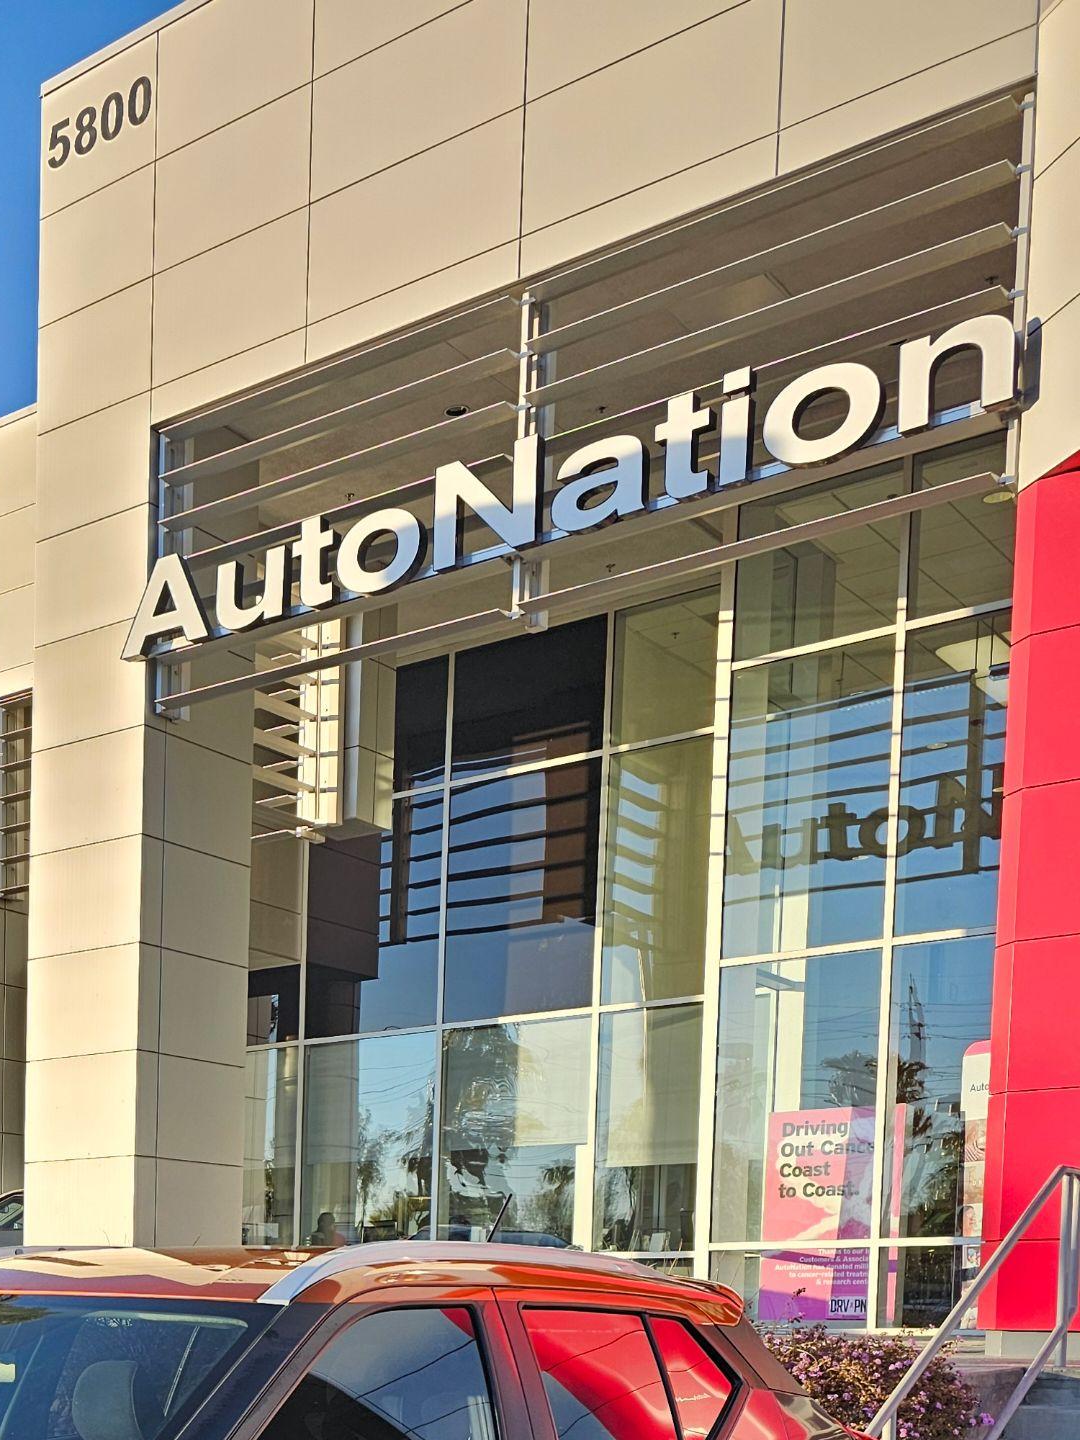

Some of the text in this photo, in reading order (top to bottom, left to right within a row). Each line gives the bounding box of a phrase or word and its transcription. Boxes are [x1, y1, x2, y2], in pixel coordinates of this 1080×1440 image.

[48, 76, 152, 169] 5800
[121, 313, 1023, 662] AutoNation
[782, 1120, 849, 1138] Driving
[780, 1142, 814, 1158] Out
[779, 1161, 831, 1178] Coast
[778, 1181, 860, 1199] to Coast.
[830, 1299, 849, 1313] DRV
